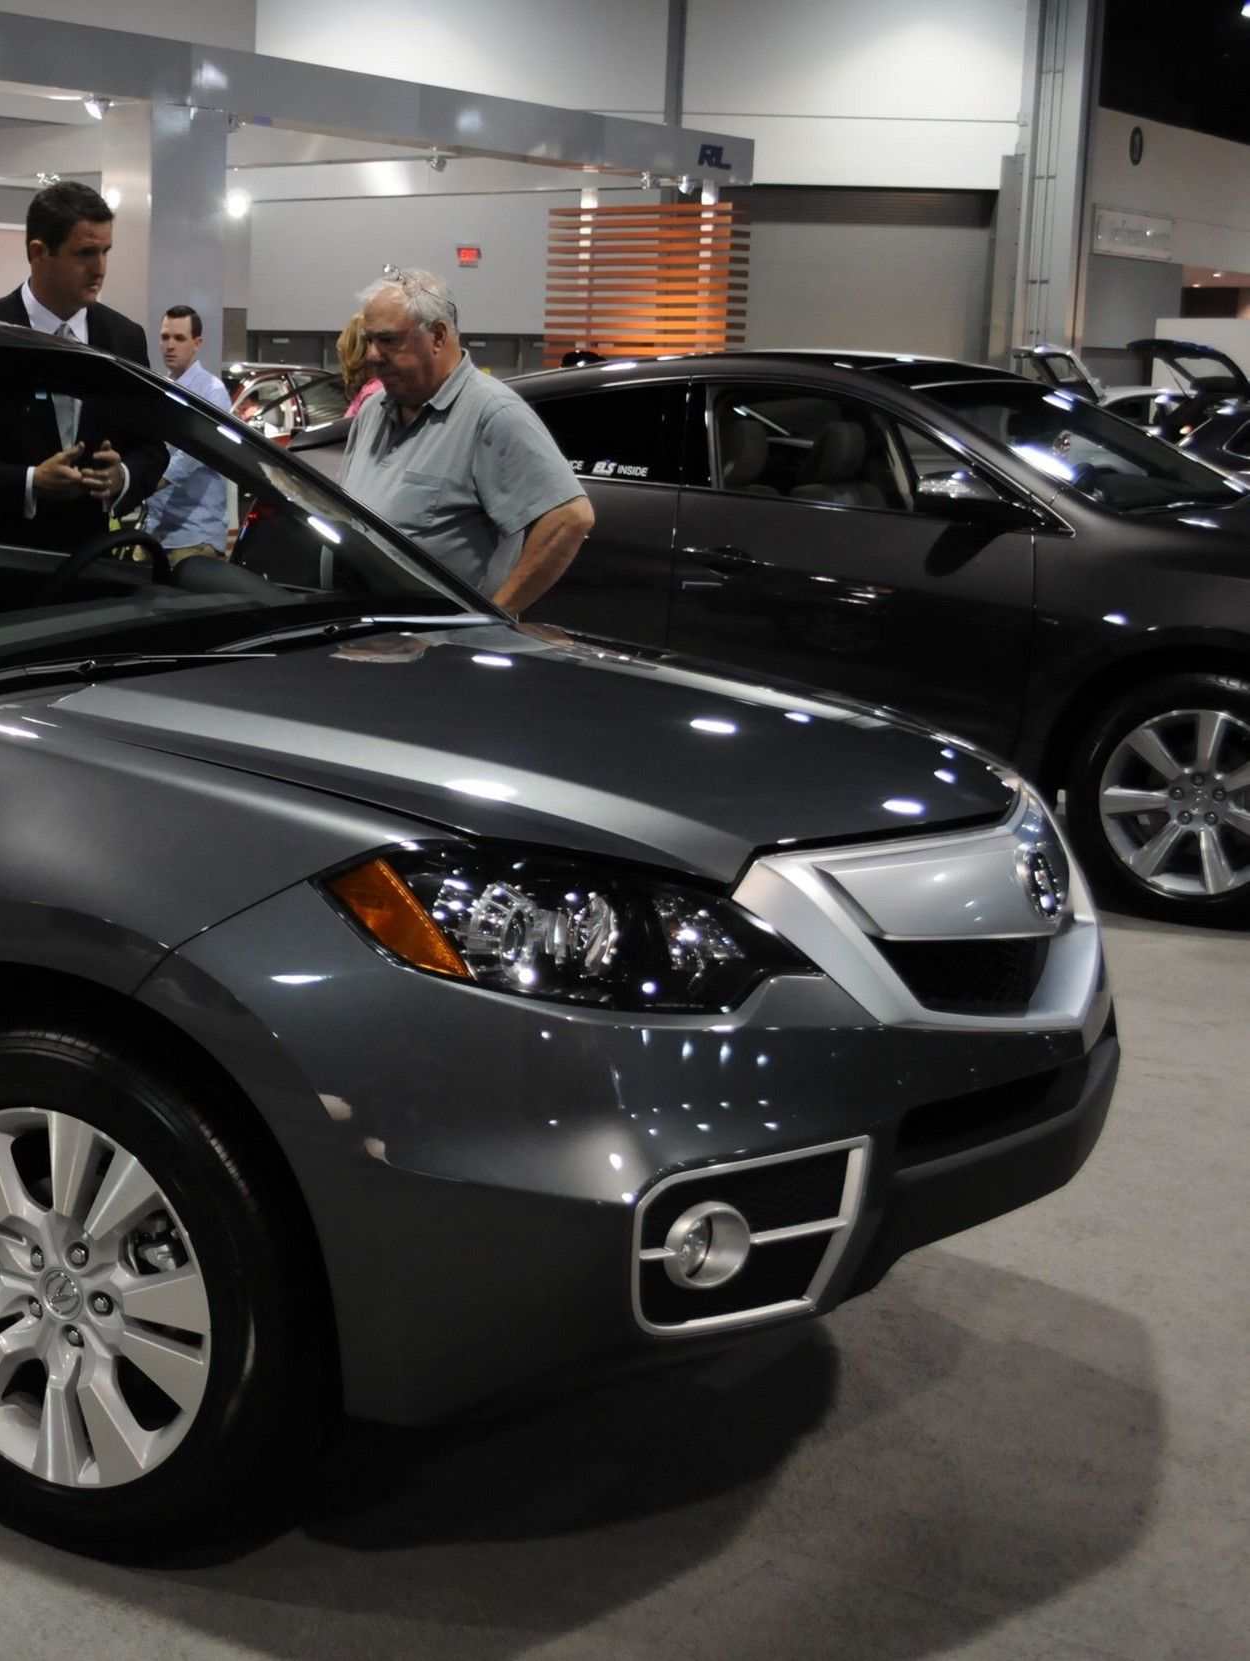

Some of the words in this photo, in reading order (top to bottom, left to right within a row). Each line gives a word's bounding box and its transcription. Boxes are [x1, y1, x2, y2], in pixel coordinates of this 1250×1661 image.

[698, 145, 732, 170] RL
[592, 461, 617, 474] ELS
[617, 465, 648, 477] INSIDE
